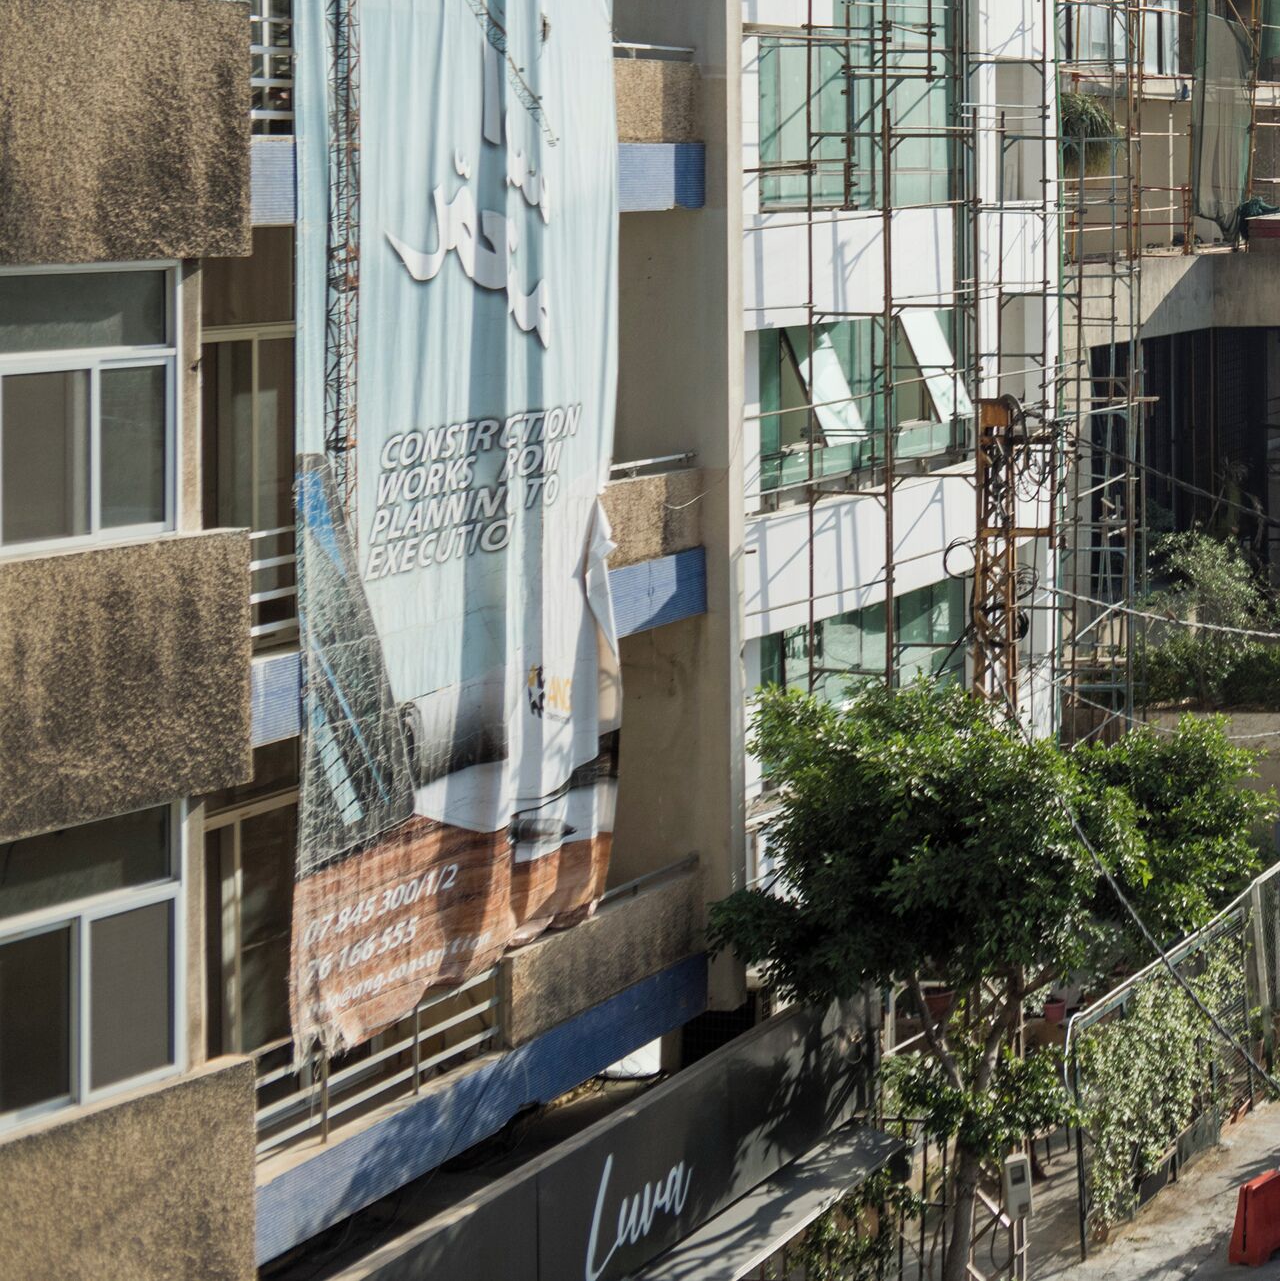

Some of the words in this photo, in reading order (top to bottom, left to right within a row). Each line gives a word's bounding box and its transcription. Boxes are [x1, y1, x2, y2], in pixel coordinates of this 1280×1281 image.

[377, 455, 476, 507] WORKS
[525, 474, 560, 509] TO
[335, 896, 376, 934] 845
[377, 863, 459, 917] 300/1/2
[338, 934, 376, 972] 166
[376, 915, 420, 955] 555
